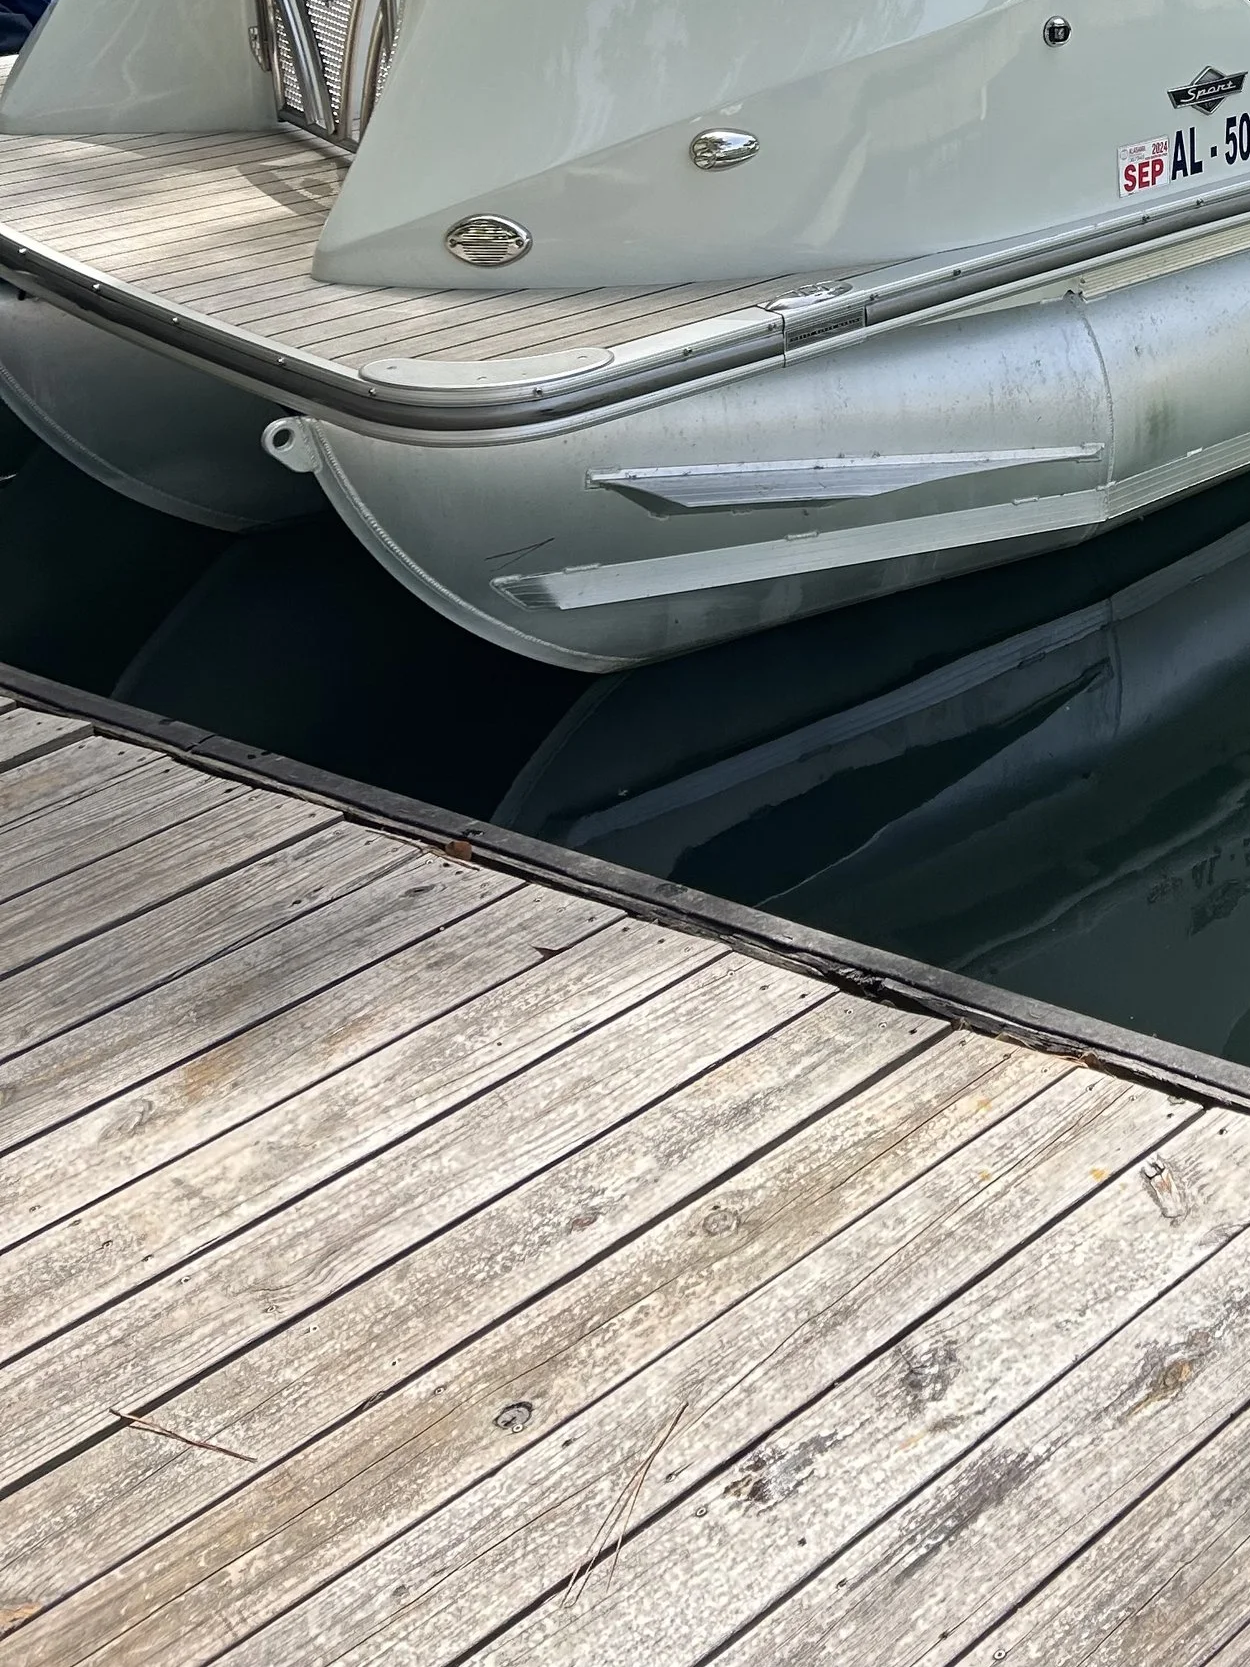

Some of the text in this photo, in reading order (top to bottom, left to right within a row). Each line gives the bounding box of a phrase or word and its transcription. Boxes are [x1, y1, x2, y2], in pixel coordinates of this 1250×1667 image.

[1180, 80, 1236, 103] Sport
[1152, 140, 1168, 154] 2024
[1124, 158, 1164, 192] SEP
